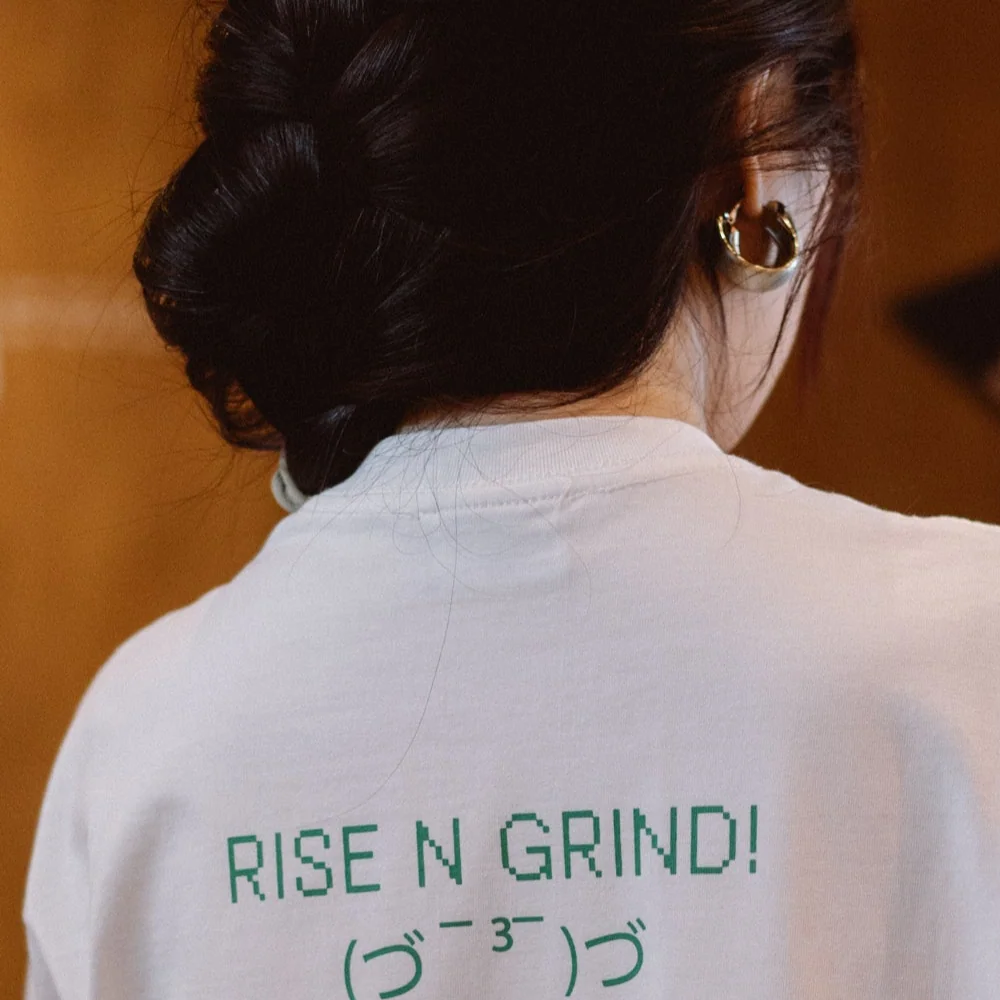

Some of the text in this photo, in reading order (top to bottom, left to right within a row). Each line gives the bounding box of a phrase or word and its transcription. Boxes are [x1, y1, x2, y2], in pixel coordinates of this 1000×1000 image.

[226, 804, 759, 905] RISE N GRIND!
